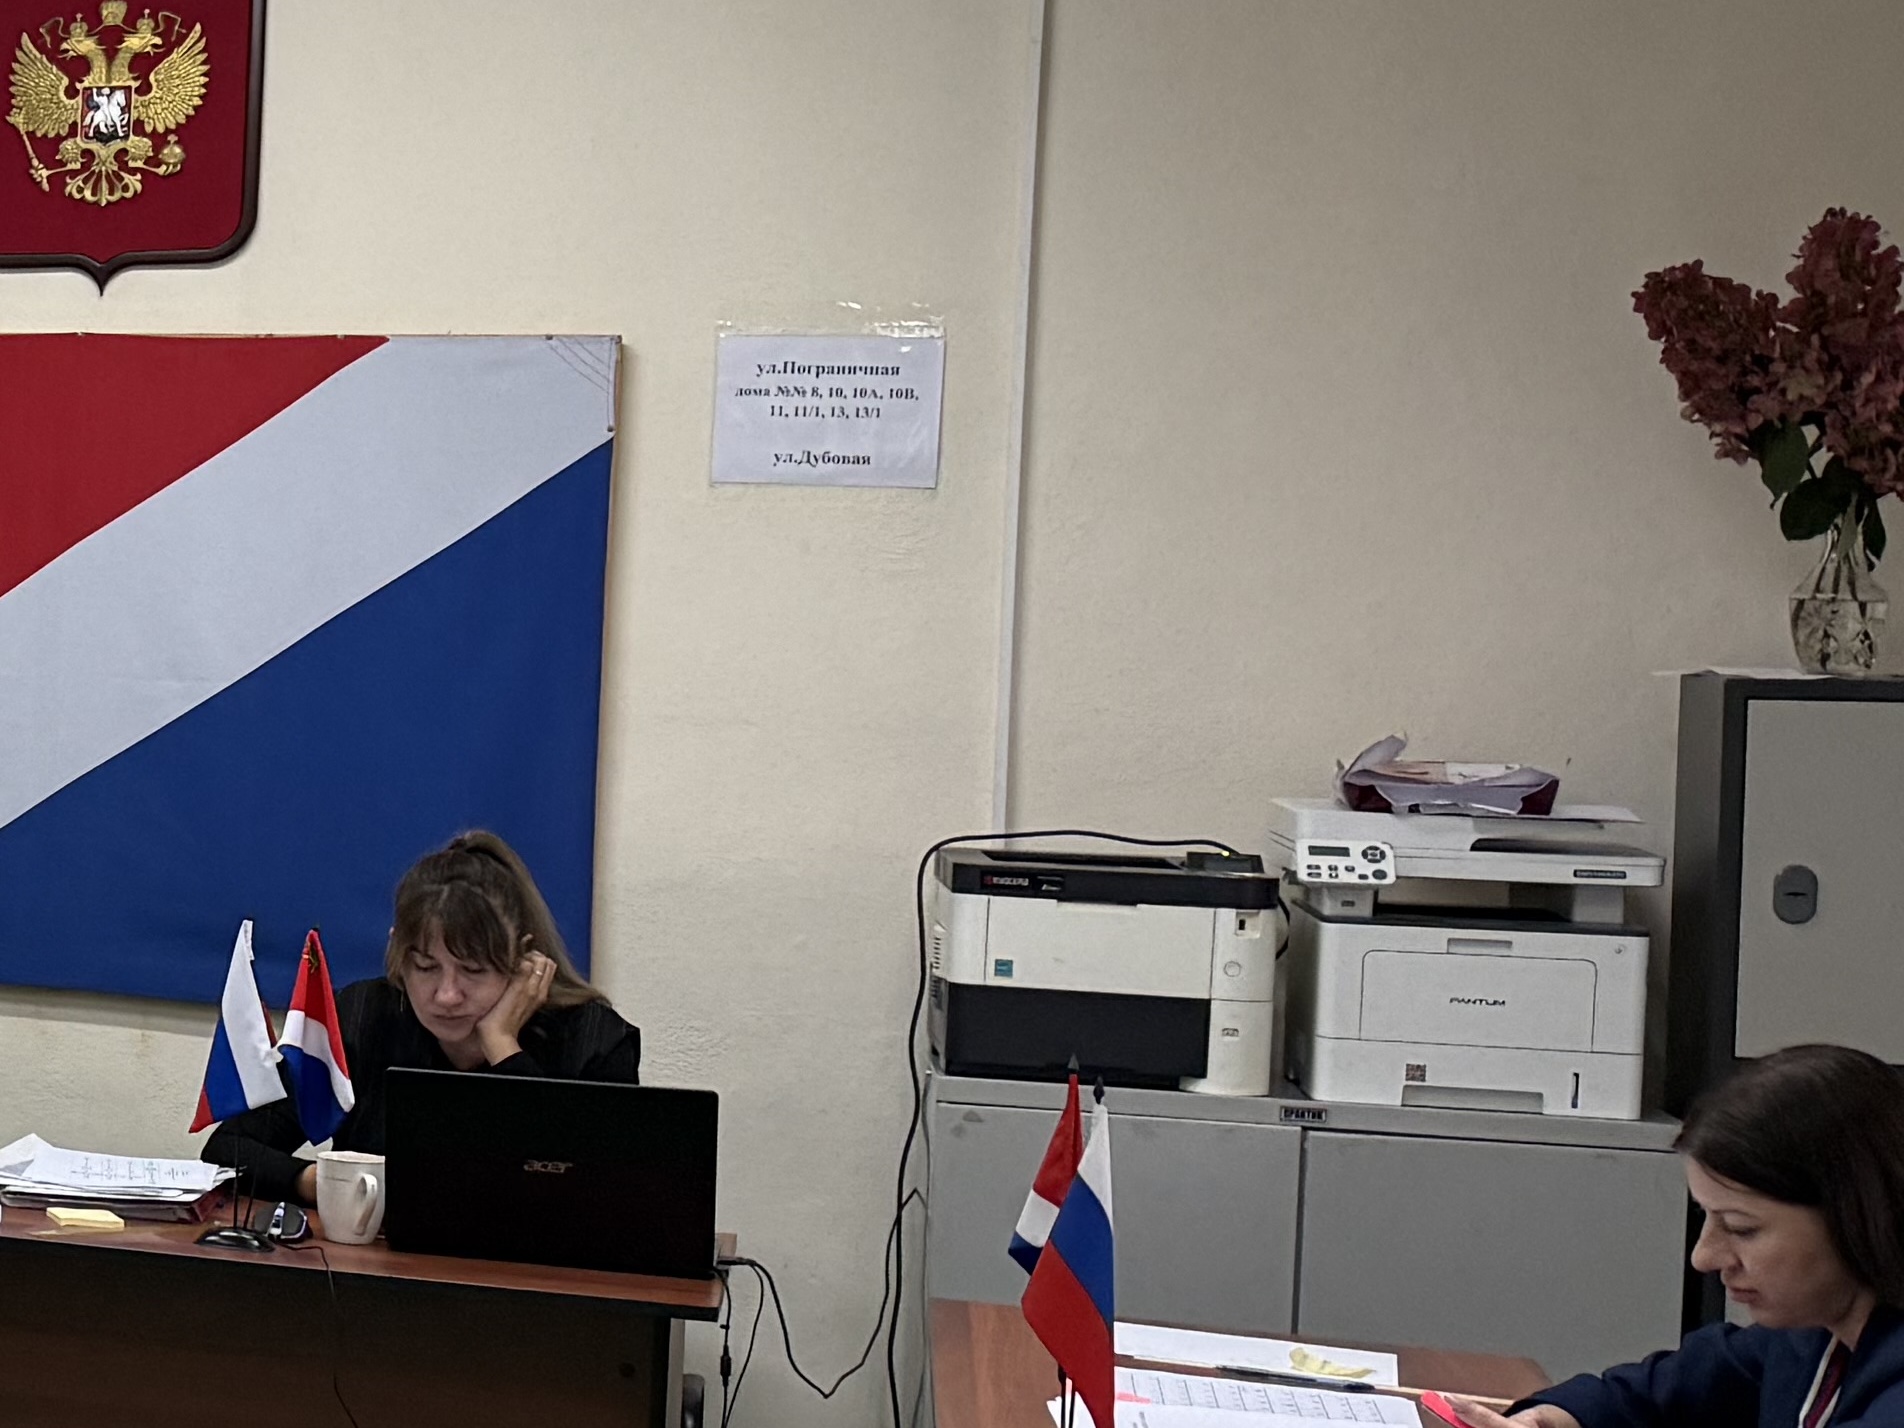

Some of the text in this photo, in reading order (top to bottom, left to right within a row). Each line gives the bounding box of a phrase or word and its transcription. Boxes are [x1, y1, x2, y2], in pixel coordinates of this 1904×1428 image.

[756, 360, 901, 379] ул.Пограничная
[734, 387, 771, 398] дома
[773, 385, 808, 398] №№
[810, 386, 824, 400] 8,
[828, 387, 848, 400] 10,
[770, 405, 881, 419] 11, 11/1, 13, 13/1
[772, 450, 872, 467] ул.Дубовая
[1449, 997, 1506, 1007] PANTUM
[523, 1159, 573, 1174] acer
